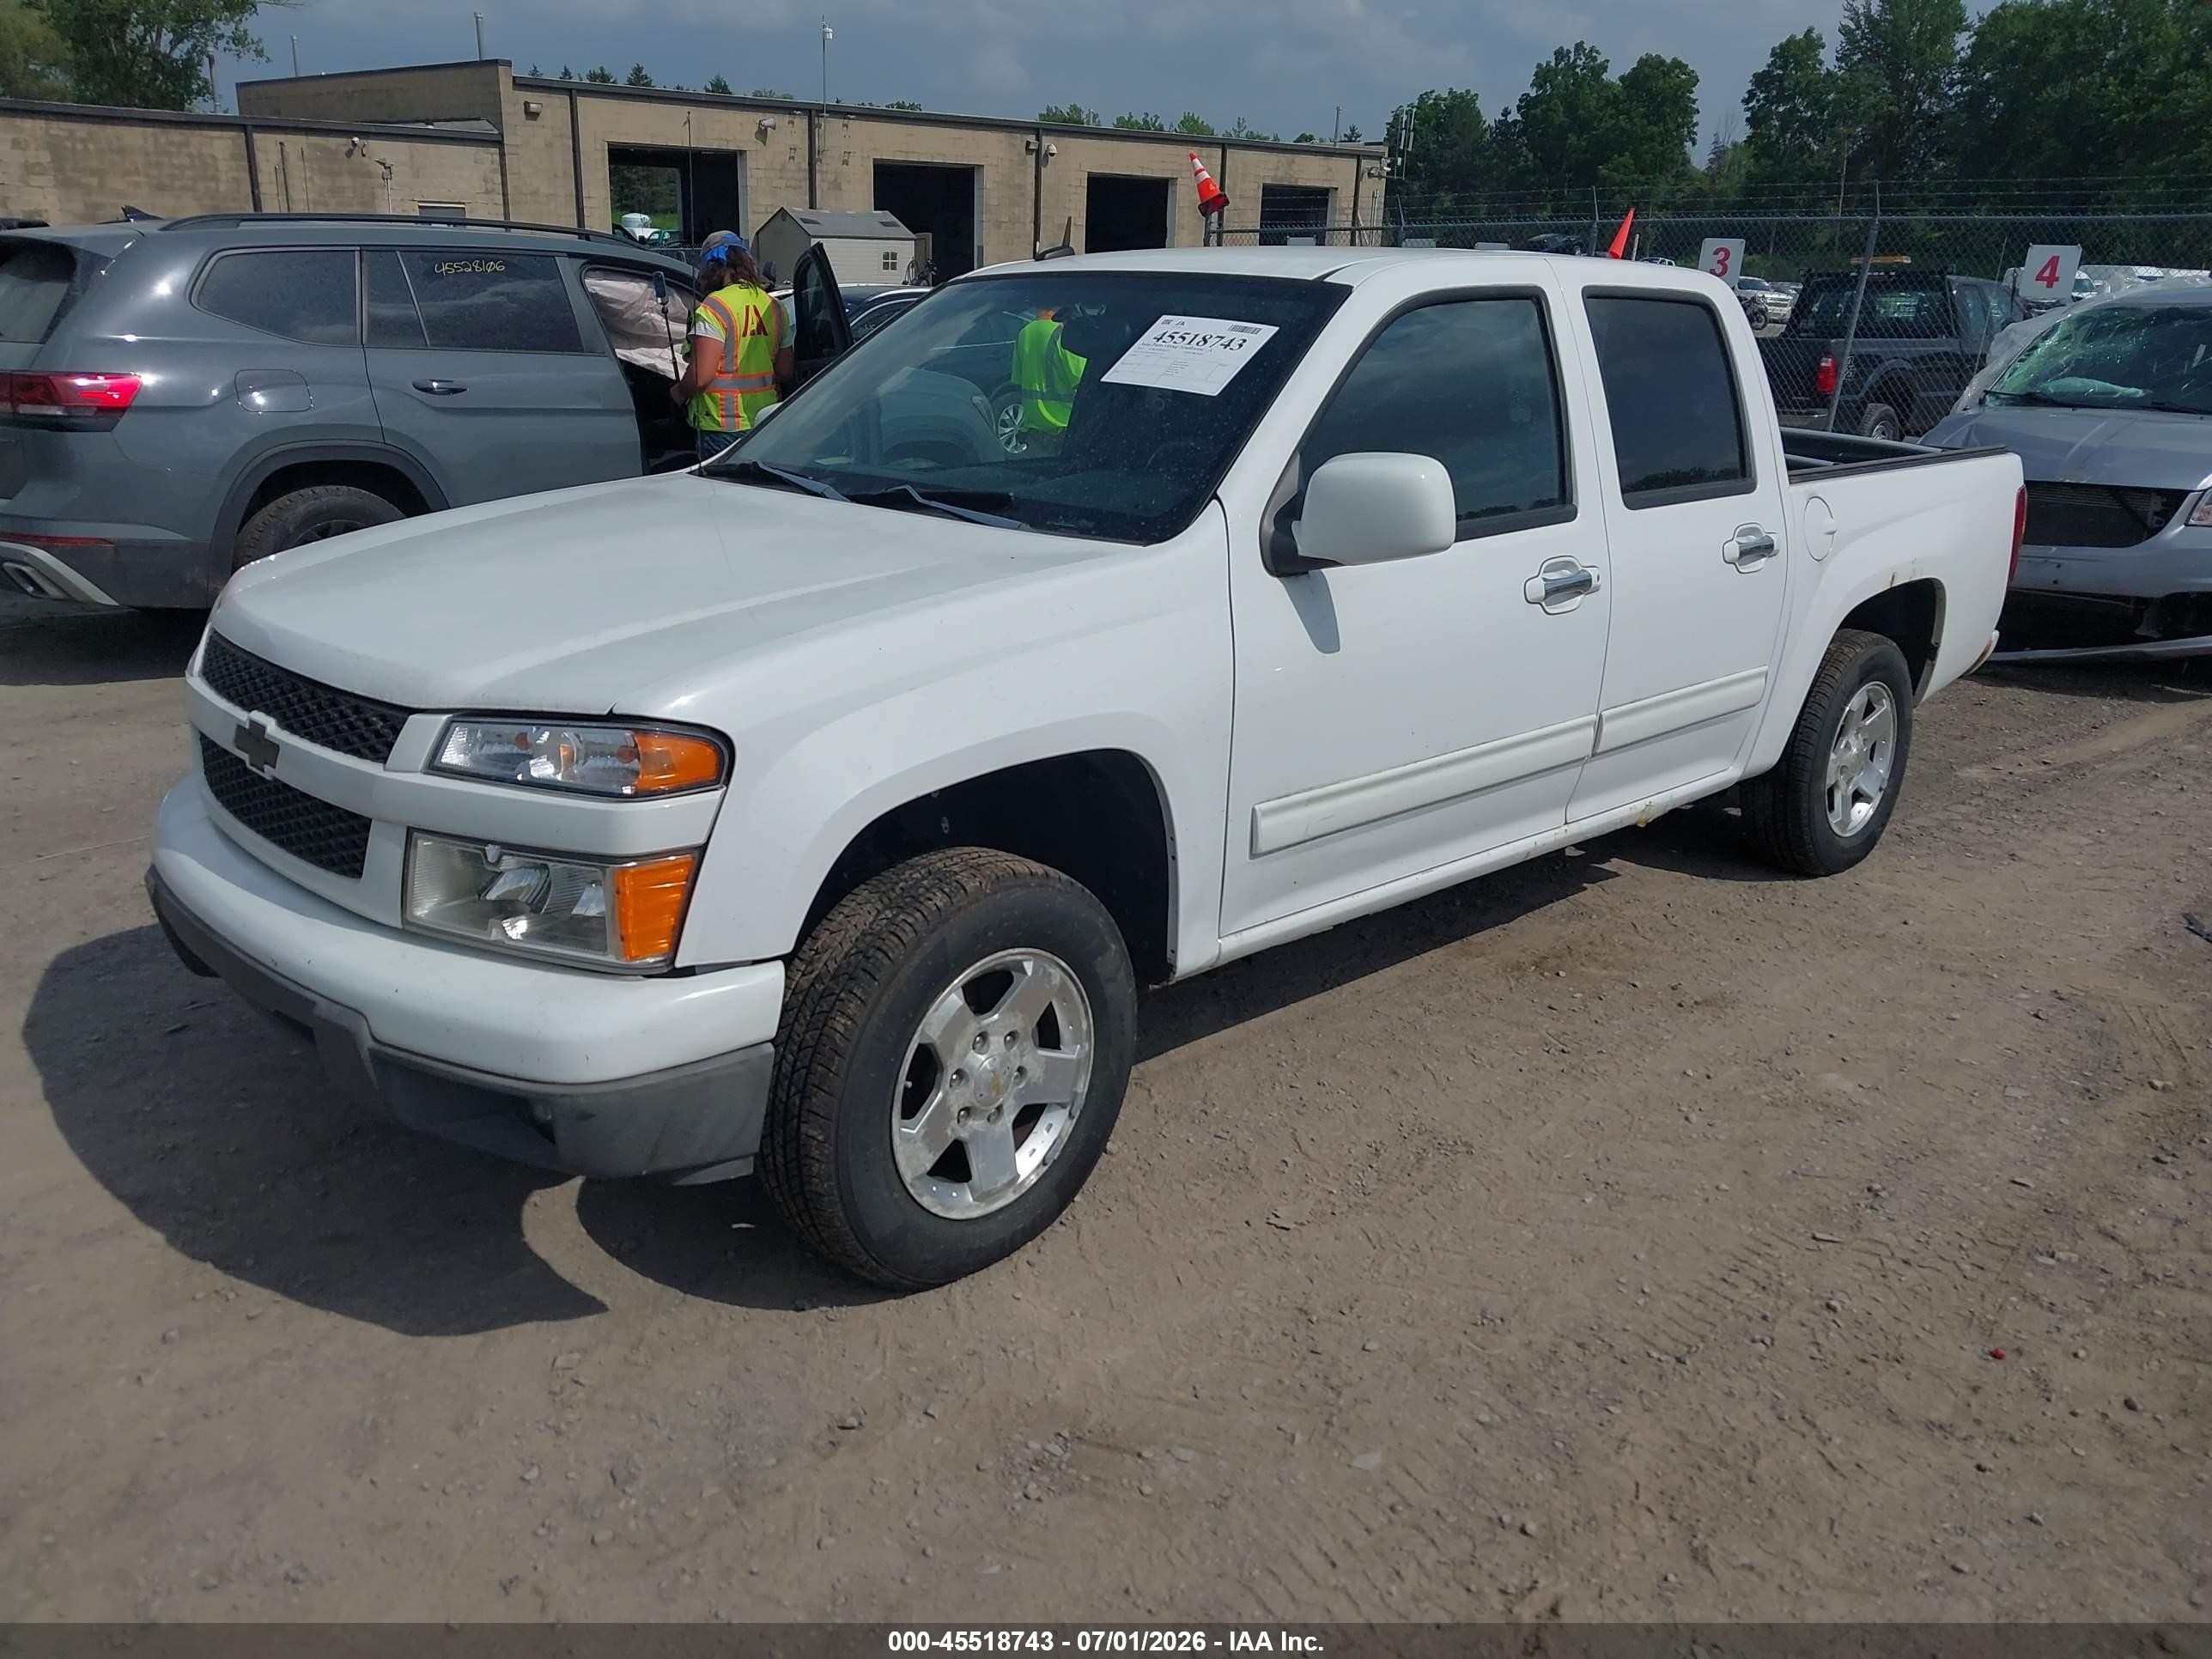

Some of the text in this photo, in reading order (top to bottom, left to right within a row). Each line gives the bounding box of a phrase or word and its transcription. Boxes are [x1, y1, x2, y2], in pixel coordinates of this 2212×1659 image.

[434, 259, 506, 276] 45528106
[1709, 246, 1731, 277] 3
[2034, 254, 2061, 289] 4
[1152, 330, 1248, 351] 45518743
